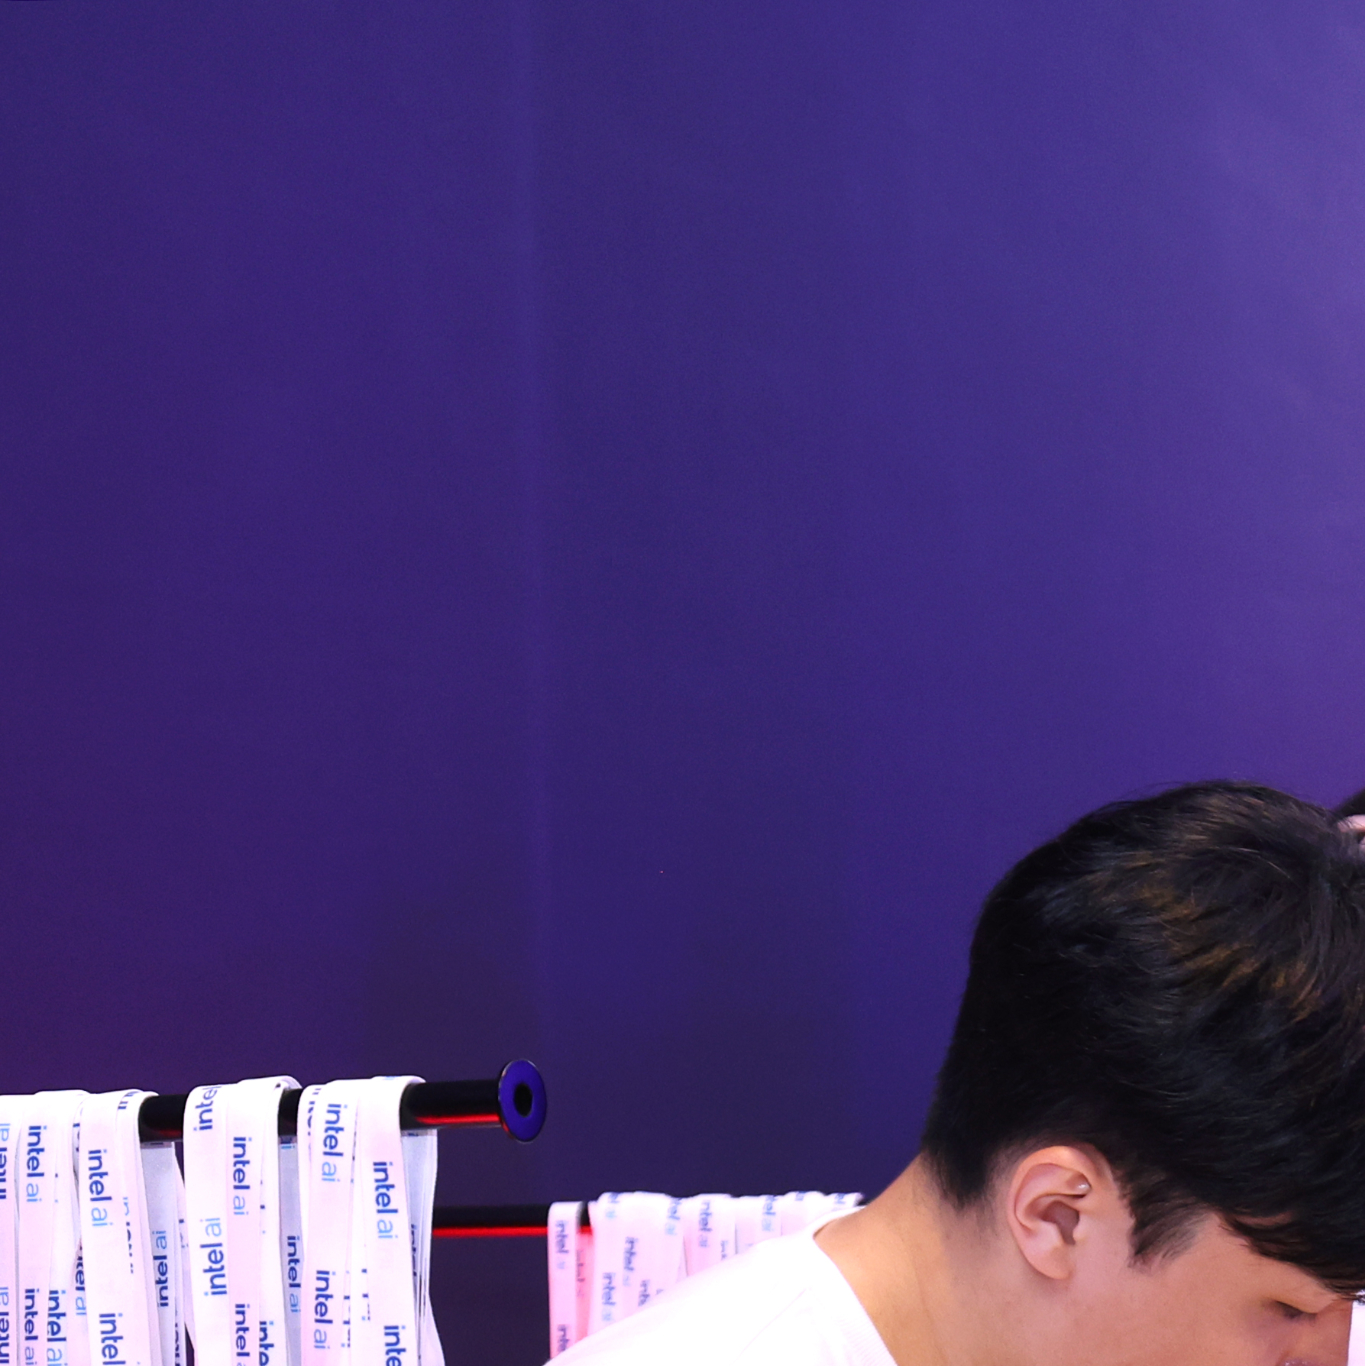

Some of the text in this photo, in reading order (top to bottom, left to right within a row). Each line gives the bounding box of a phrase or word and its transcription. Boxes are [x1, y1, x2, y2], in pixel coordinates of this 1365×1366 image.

[26, 1125, 47, 1203] intel ai
[232, 1137, 252, 1215] intel ai
[321, 1103, 348, 1182] intel ai
[89, 1149, 113, 1227] intel ai
[372, 1161, 398, 1238] intel ai
[152, 1231, 168, 1307] intel ai
[200, 1218, 228, 1296] intel ai
[287, 1235, 301, 1288] intel
[24, 1288, 40, 1365] intel ai
[46, 1290, 68, 1366] intel ai
[99, 1313, 126, 1365] intel
[235, 1304, 250, 1357] intel
[314, 1270, 336, 1349] intel ai
